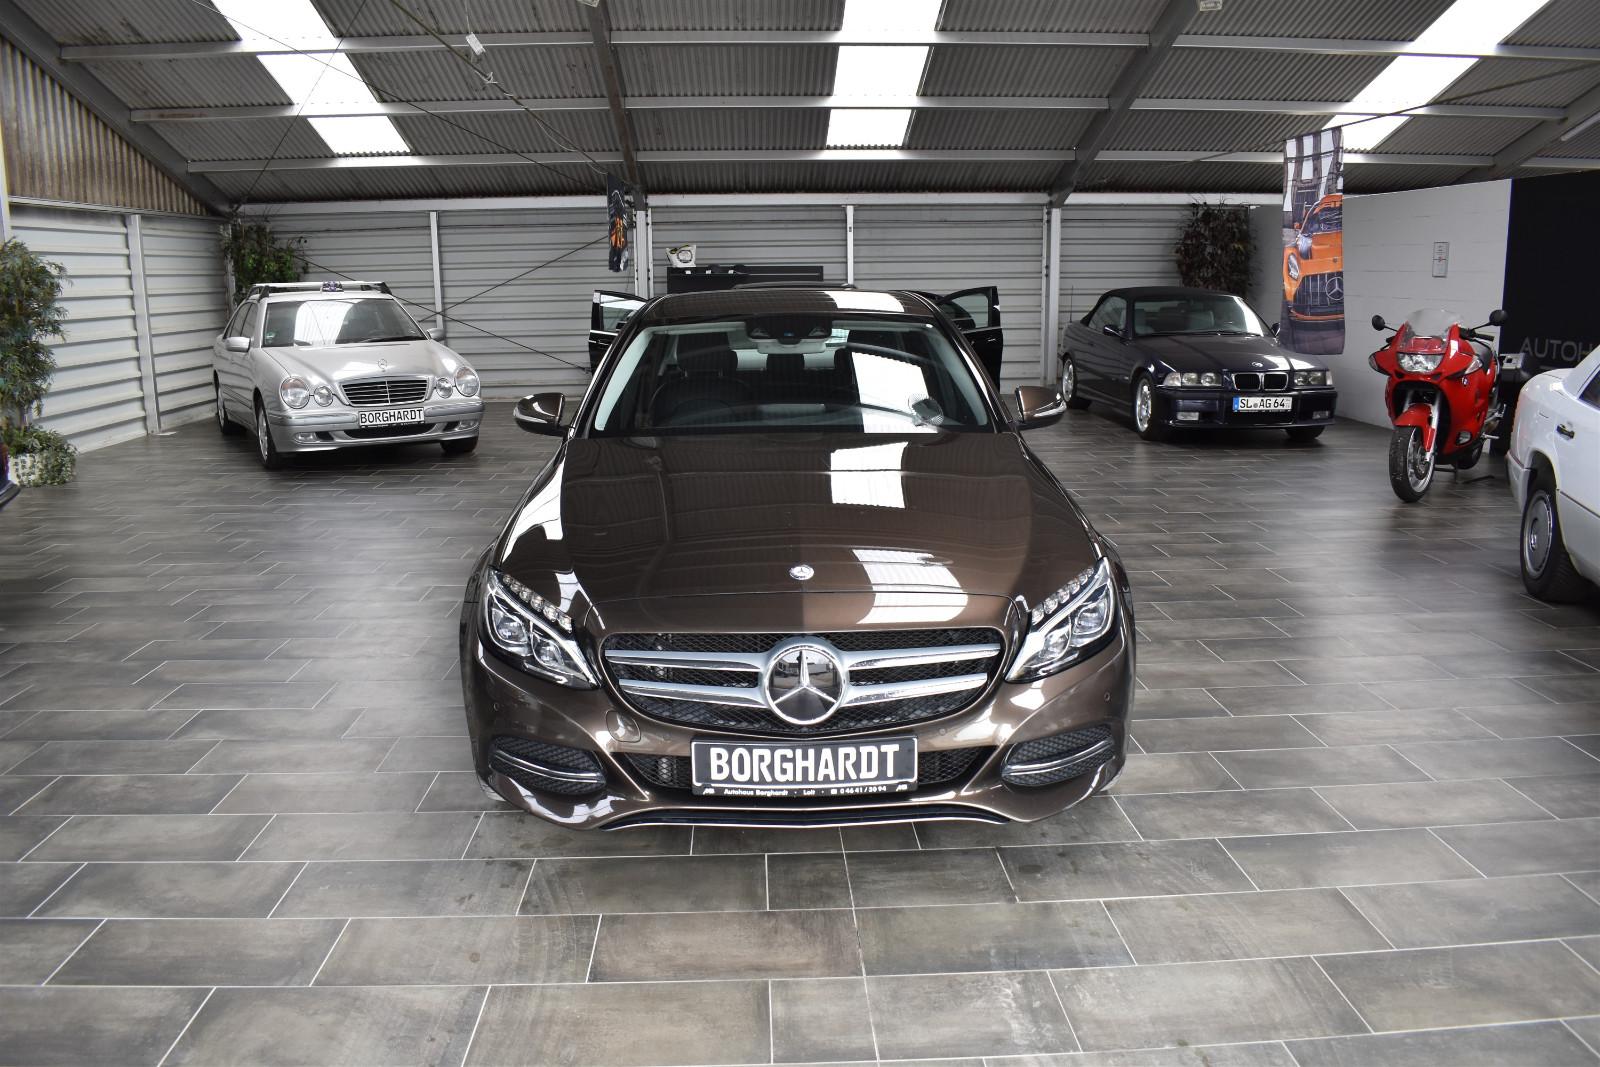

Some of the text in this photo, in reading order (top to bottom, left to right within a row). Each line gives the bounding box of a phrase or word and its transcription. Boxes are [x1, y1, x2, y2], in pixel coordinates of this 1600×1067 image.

[1240, 398, 1285, 409] SL AG 64
[360, 409, 423, 424] BORGHARDT
[710, 744, 900, 783] BORGHARDT
[724, 788, 754, 796] Autohaus
[755, 789, 789, 797] Borghardt
